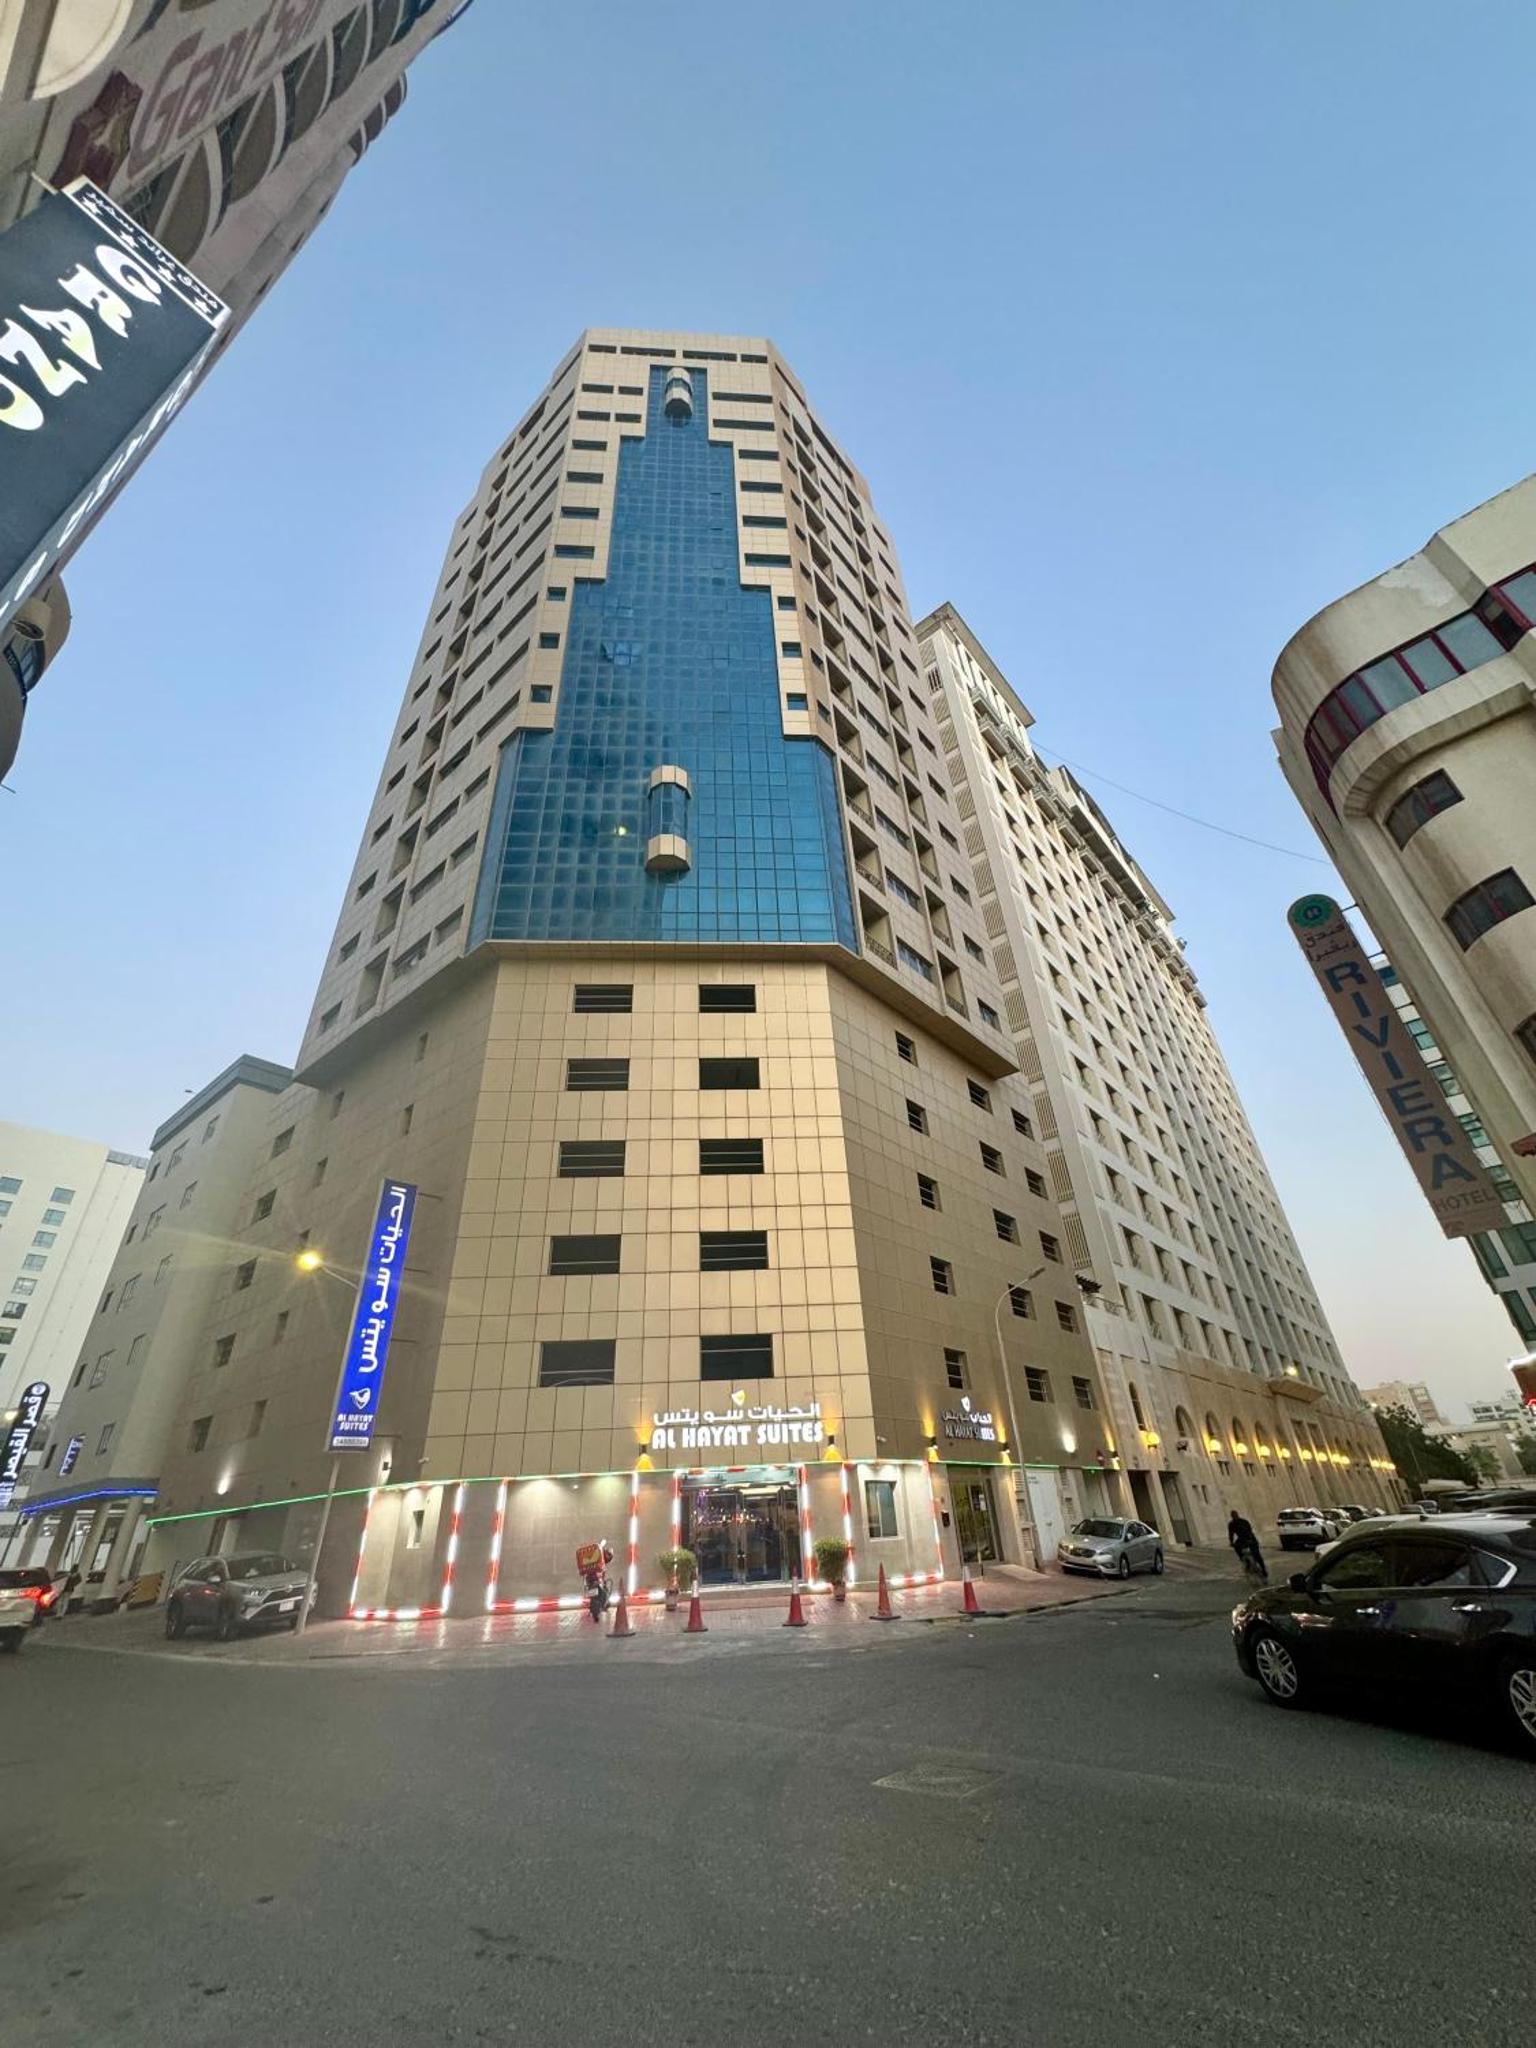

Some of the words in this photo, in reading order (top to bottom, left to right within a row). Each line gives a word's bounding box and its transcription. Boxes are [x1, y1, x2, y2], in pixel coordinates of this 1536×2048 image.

[1326, 963, 1477, 1188] RIVIERA
[1434, 1188, 1497, 1214] HOTEL
[24, 1395, 43, 1428] قصر
[747, 1402, 821, 1421] الحيات
[652, 1428, 677, 1449] AL
[682, 1424, 752, 1448] HAYAT
[756, 1422, 824, 1445] SUITES
